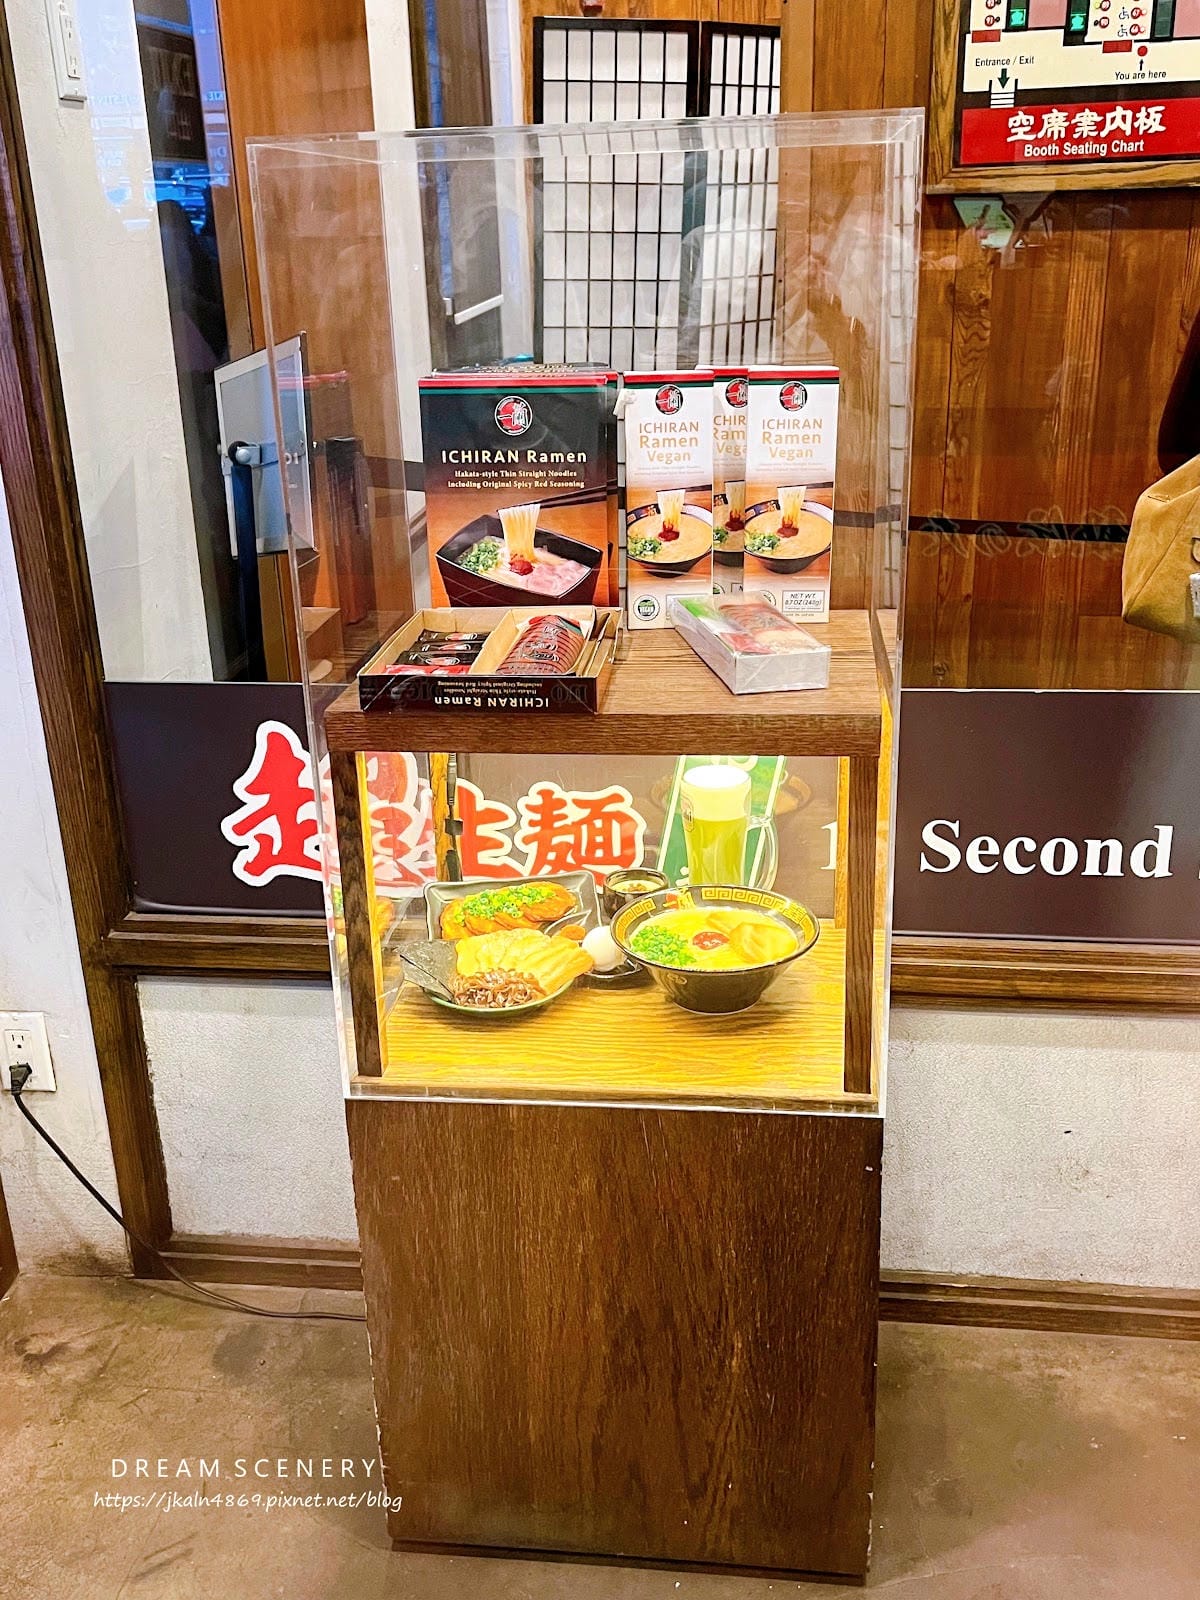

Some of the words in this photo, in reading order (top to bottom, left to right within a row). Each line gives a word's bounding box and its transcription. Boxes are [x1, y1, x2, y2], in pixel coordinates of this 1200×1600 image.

[975, 57, 1010, 66] Entrance
[1019, 56, 1034, 64] Exit
[1115, 71, 1130, 80] You
[1148, 70, 1166, 78] here
[1006, 105, 1167, 142] 空席案内板
[1024, 144, 1060, 157] Booth
[1063, 141, 1108, 156] Seating
[1111, 139, 1144, 152] Chart
[714, 415, 746, 426] CHIR
[762, 418, 823, 430] ICHIRAN
[639, 422, 699, 434] ICHIRAN
[713, 428, 746, 440] Ram
[639, 435, 698, 448] Ramen
[762, 431, 822, 444] Ramen
[442, 450, 520, 464] ICHIRAN
[527, 450, 588, 463] Ramen
[647, 450, 691, 464] Vegan
[768, 447, 814, 460] Vegan
[454, 470, 498, 479] Hakata-style
[518, 470, 546, 478] Straight
[482, 480, 512, 489] Original
[514, 480, 532, 489] Spicy
[550, 480, 584, 488] Seasoning
[434, 696, 482, 706] Ramen
[488, 697, 548, 708] ICHIRAN
[919, 819, 1174, 878] Second
